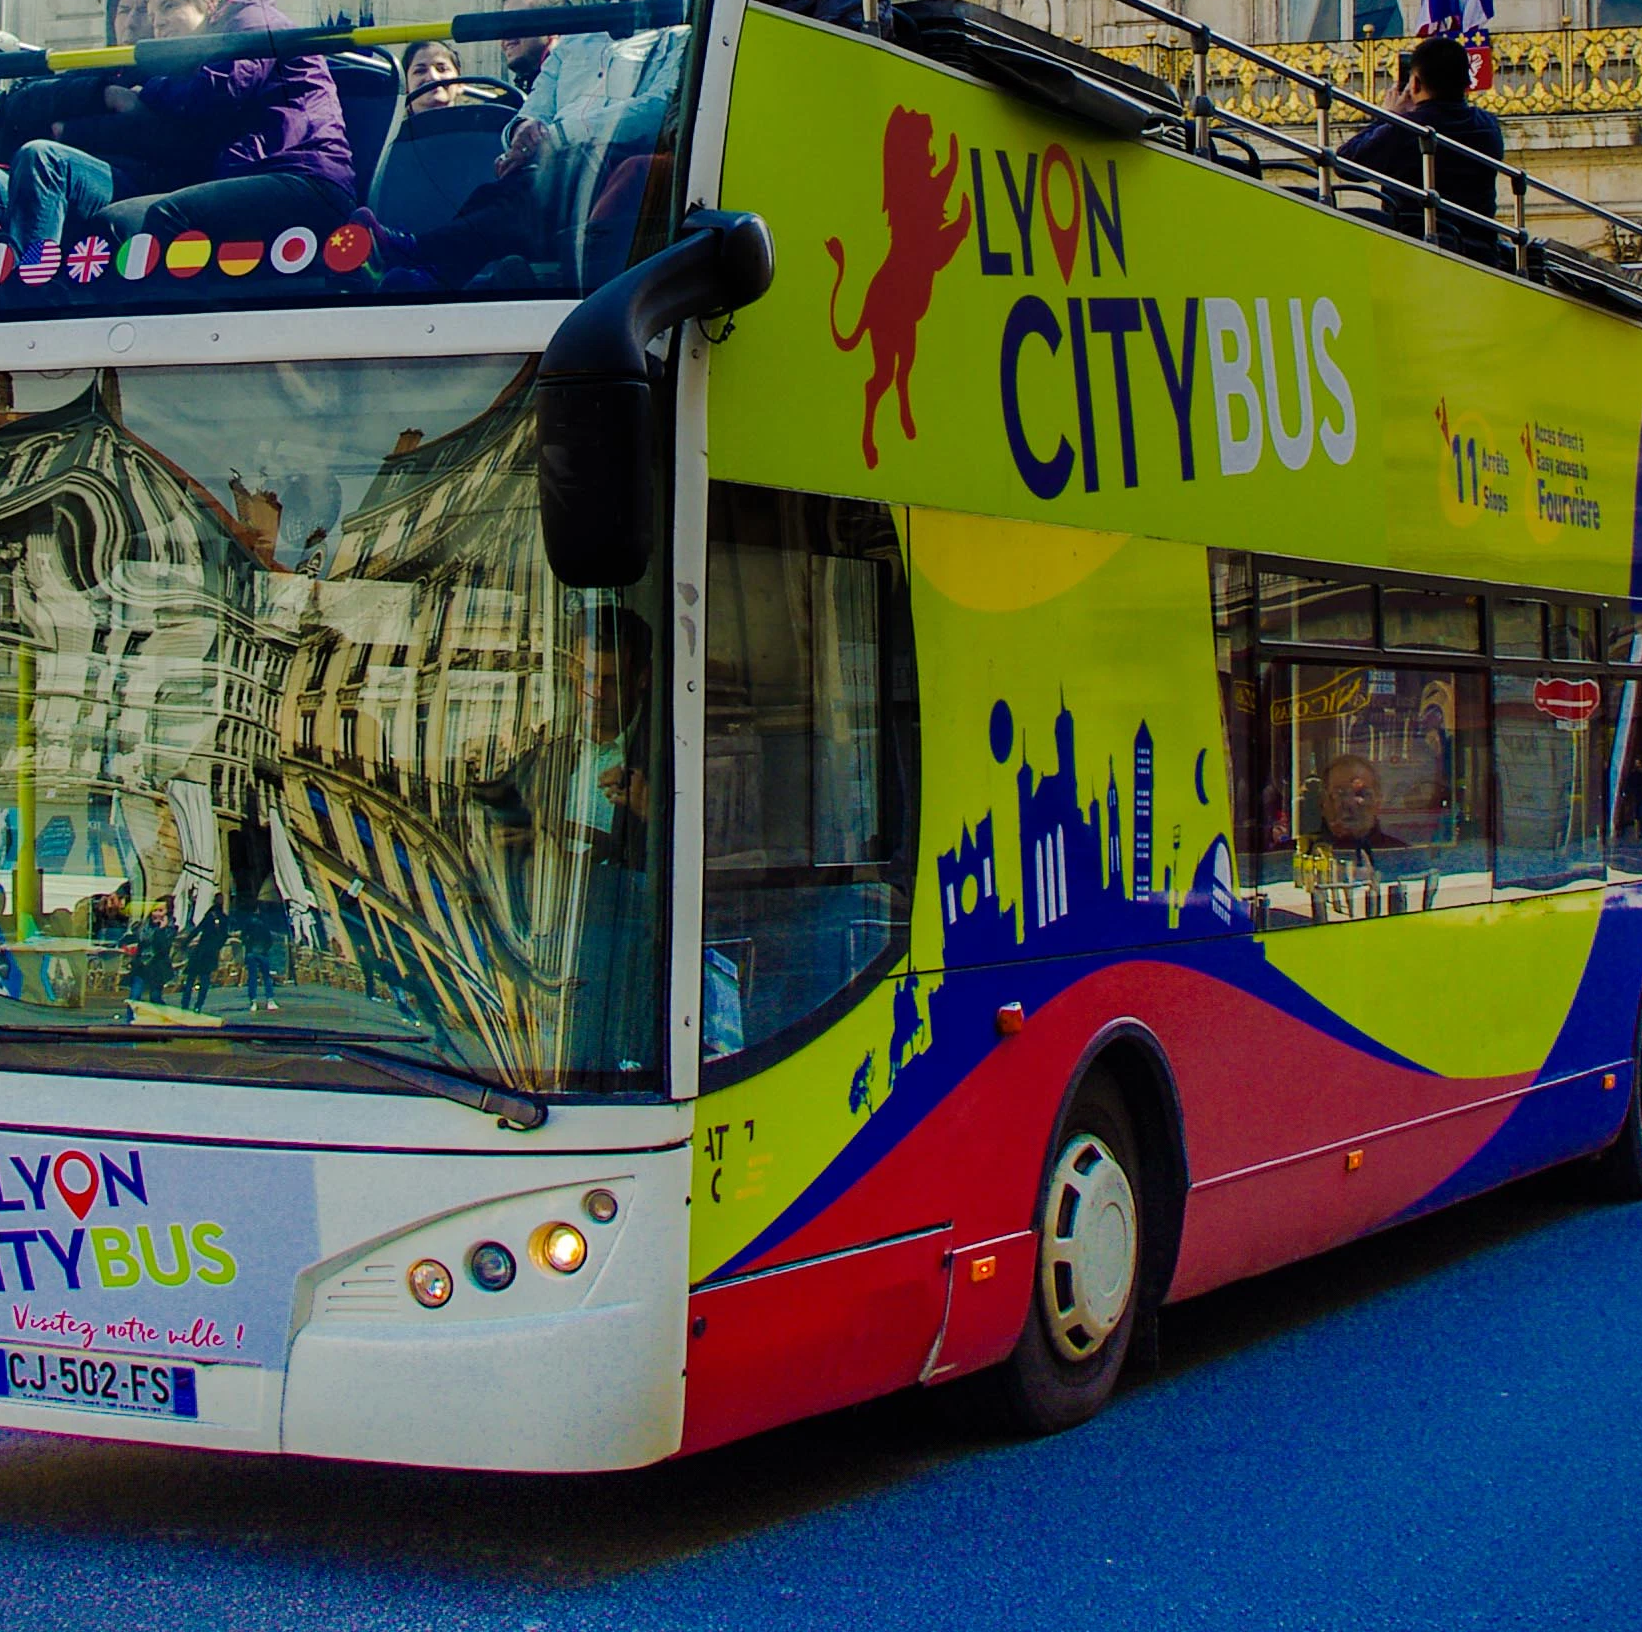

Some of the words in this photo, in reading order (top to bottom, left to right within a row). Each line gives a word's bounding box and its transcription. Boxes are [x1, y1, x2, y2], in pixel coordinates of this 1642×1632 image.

[969, 142, 1127, 284] LYON
[1001, 294, 1357, 500] CITYBUS
[1452, 434, 1479, 506] 11
[1481, 447, 1510, 476] Arrêts
[1536, 449, 1554, 478] Easy
[1483, 485, 1509, 517] Stops
[1537, 478, 1601, 531] Fourvière
[12, 1304, 98, 1349] Visitez
[105, 1317, 160, 1344] notre
[168, 1317, 226, 1349] ville
[8, 1352, 170, 1405] CJ-502-FS
